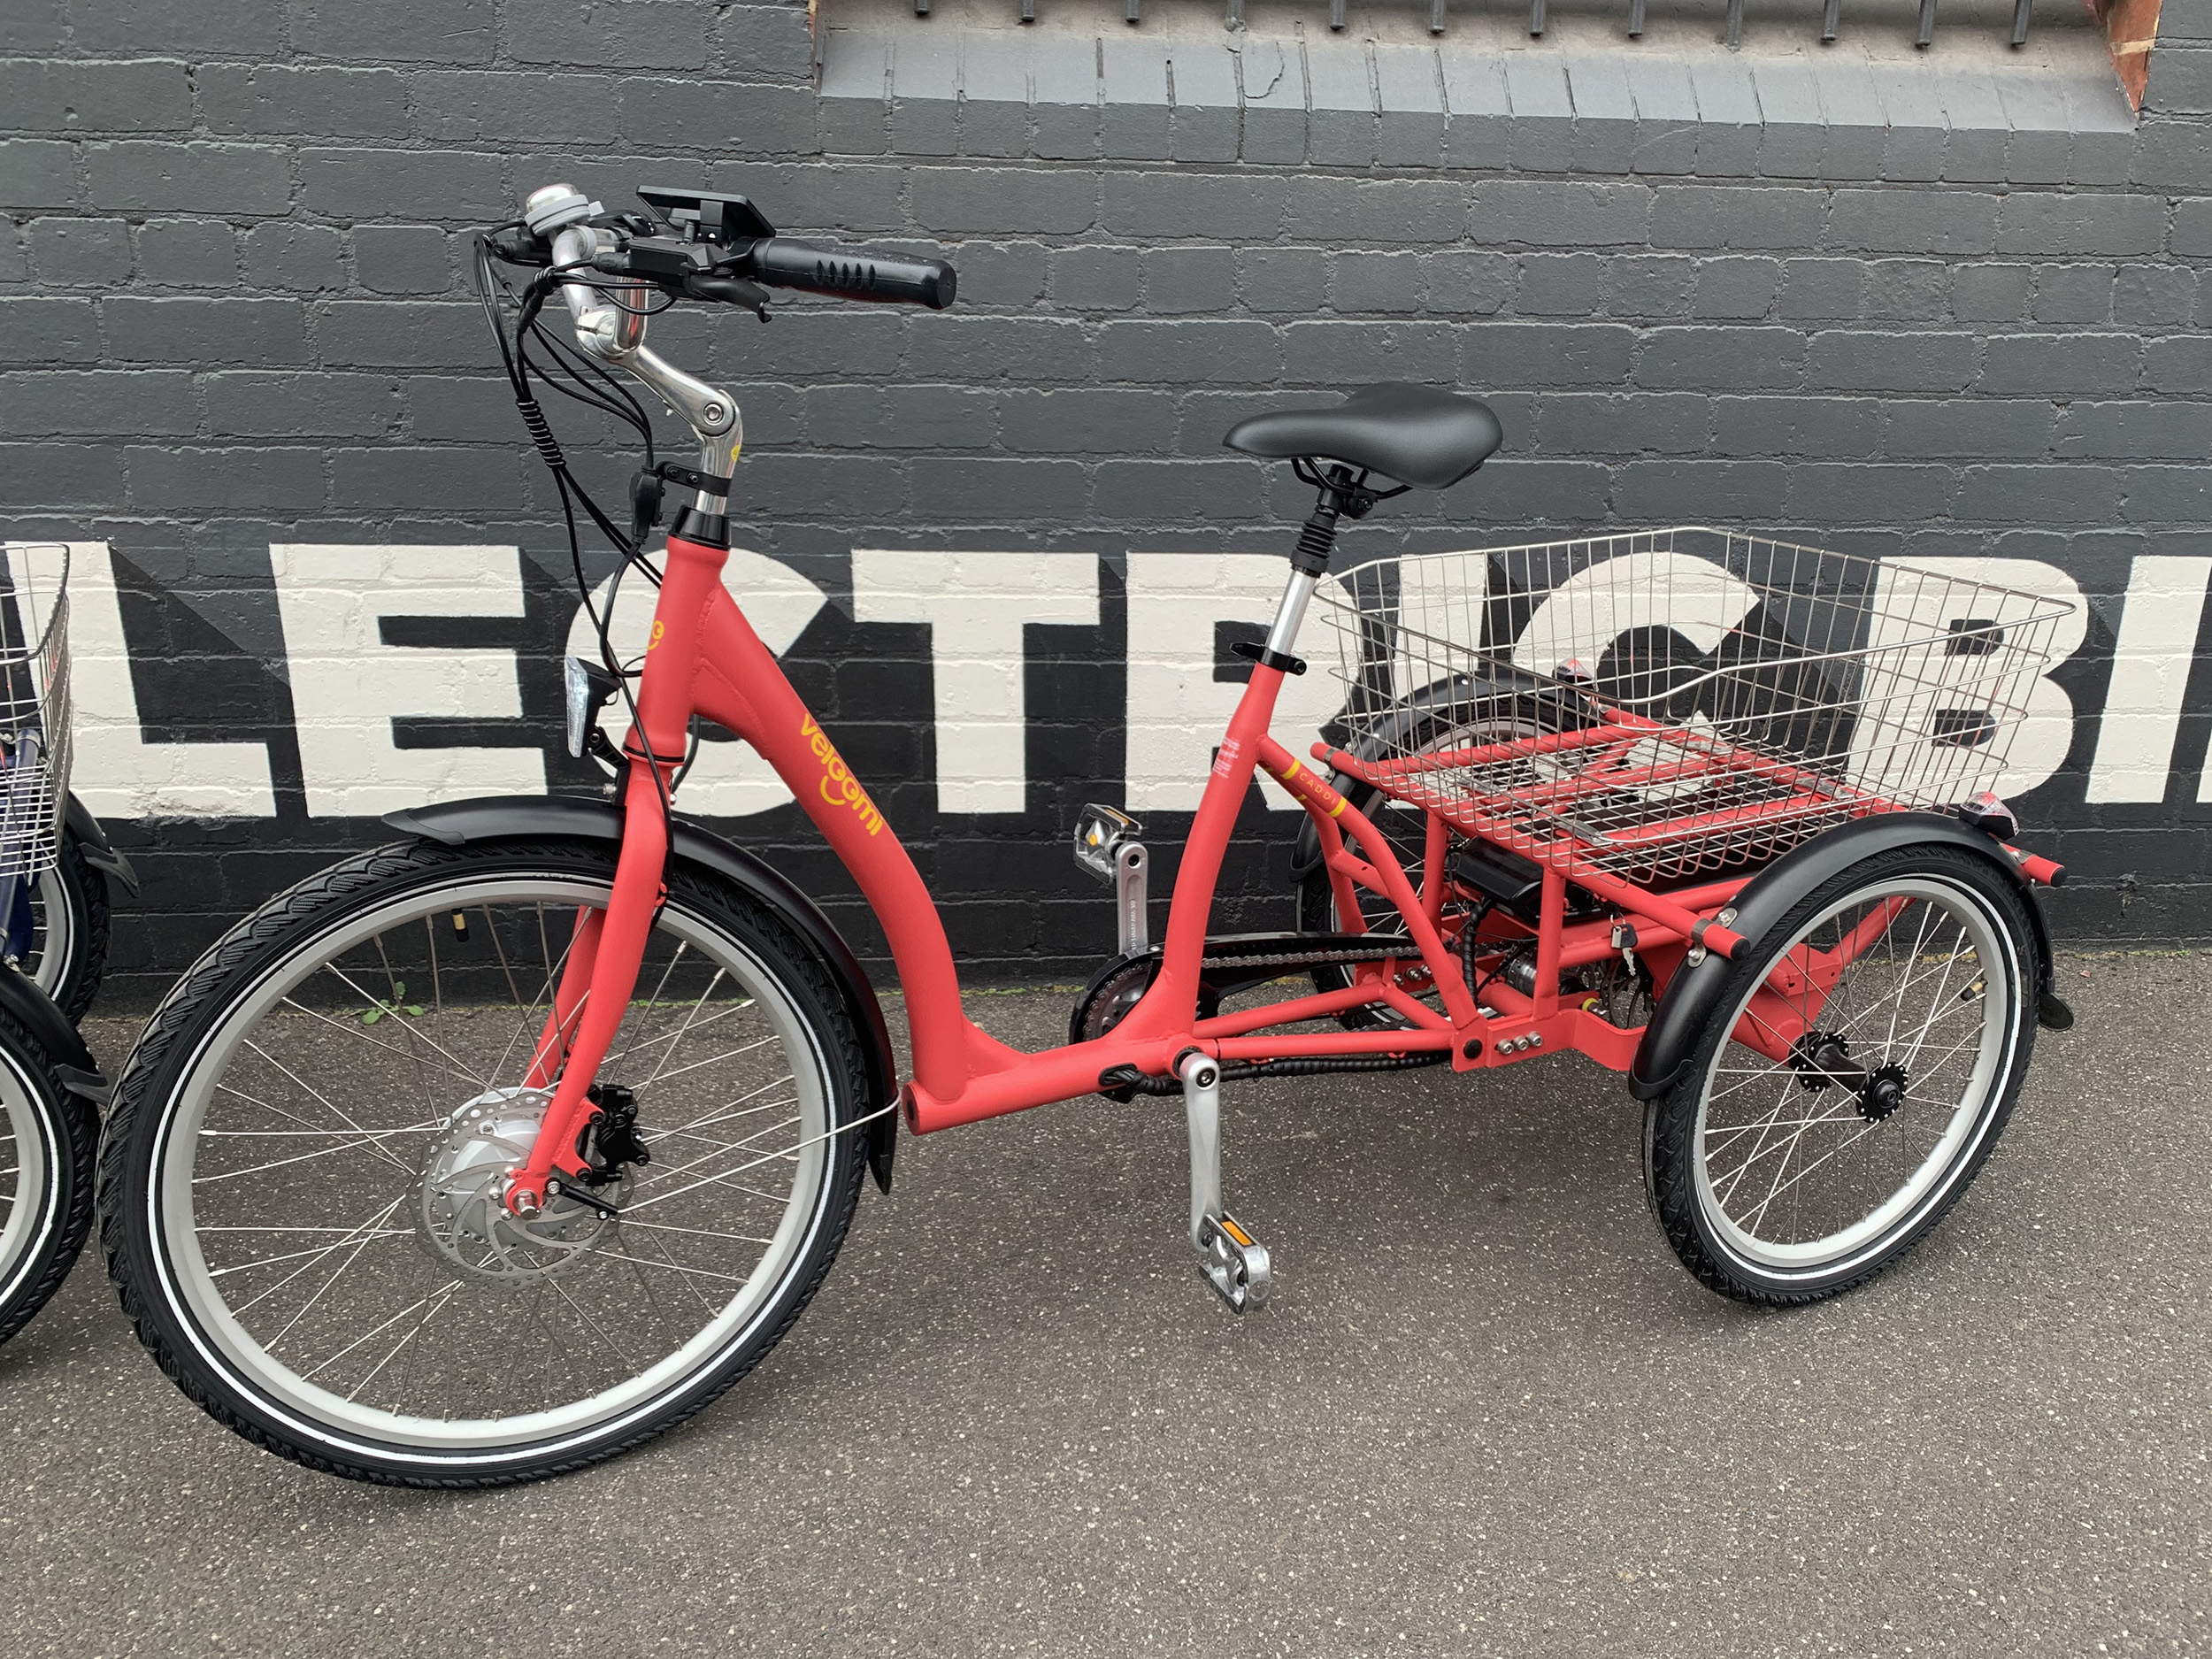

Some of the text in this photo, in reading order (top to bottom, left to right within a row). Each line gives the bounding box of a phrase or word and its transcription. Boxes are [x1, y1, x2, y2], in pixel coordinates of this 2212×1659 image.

[1841, 554, 2212, 809] BI
[800, 712, 884, 836] veloomi
[1298, 772, 1336, 804] CADDI
